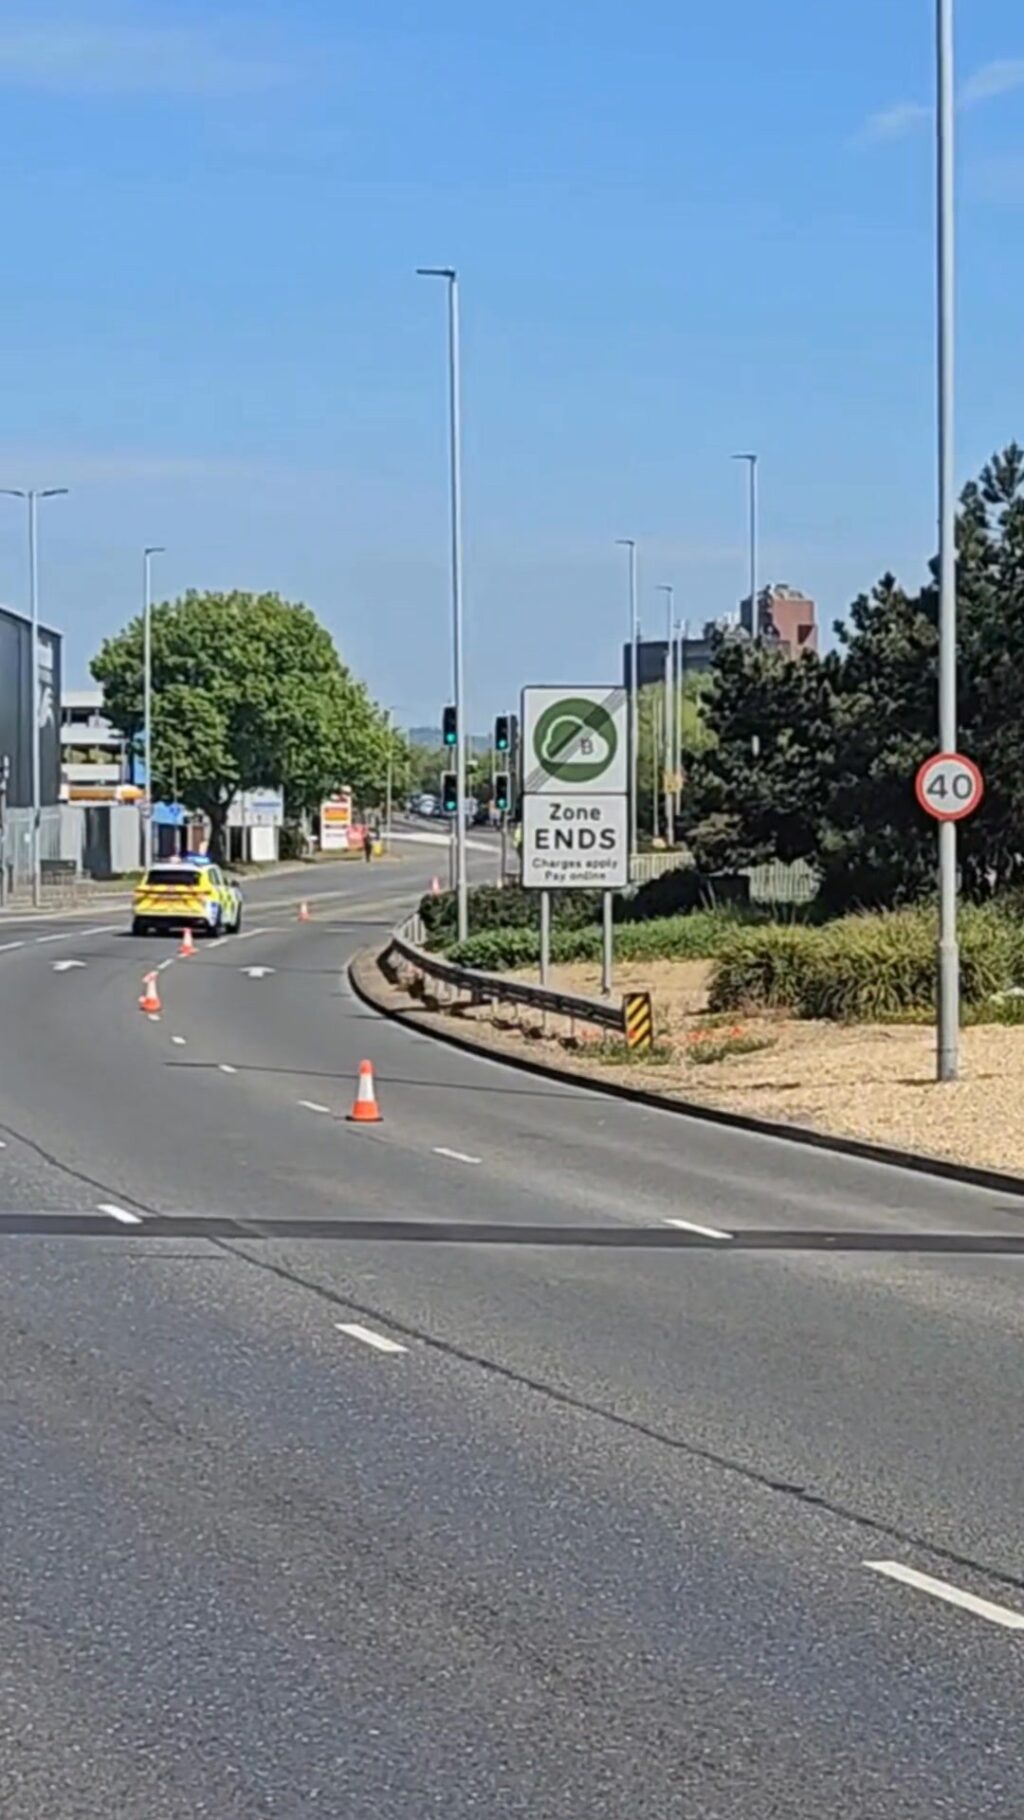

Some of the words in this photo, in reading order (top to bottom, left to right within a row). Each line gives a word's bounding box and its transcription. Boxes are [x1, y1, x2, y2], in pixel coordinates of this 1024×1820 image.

[926, 774, 973, 799] 40
[549, 803, 601, 821] Zone
[535, 828, 616, 850] ENDS
[532, 857, 582, 871] Charges
[585, 858, 618, 871] apply
[545, 871, 566, 882] Pay
[569, 871, 606, 881] online
